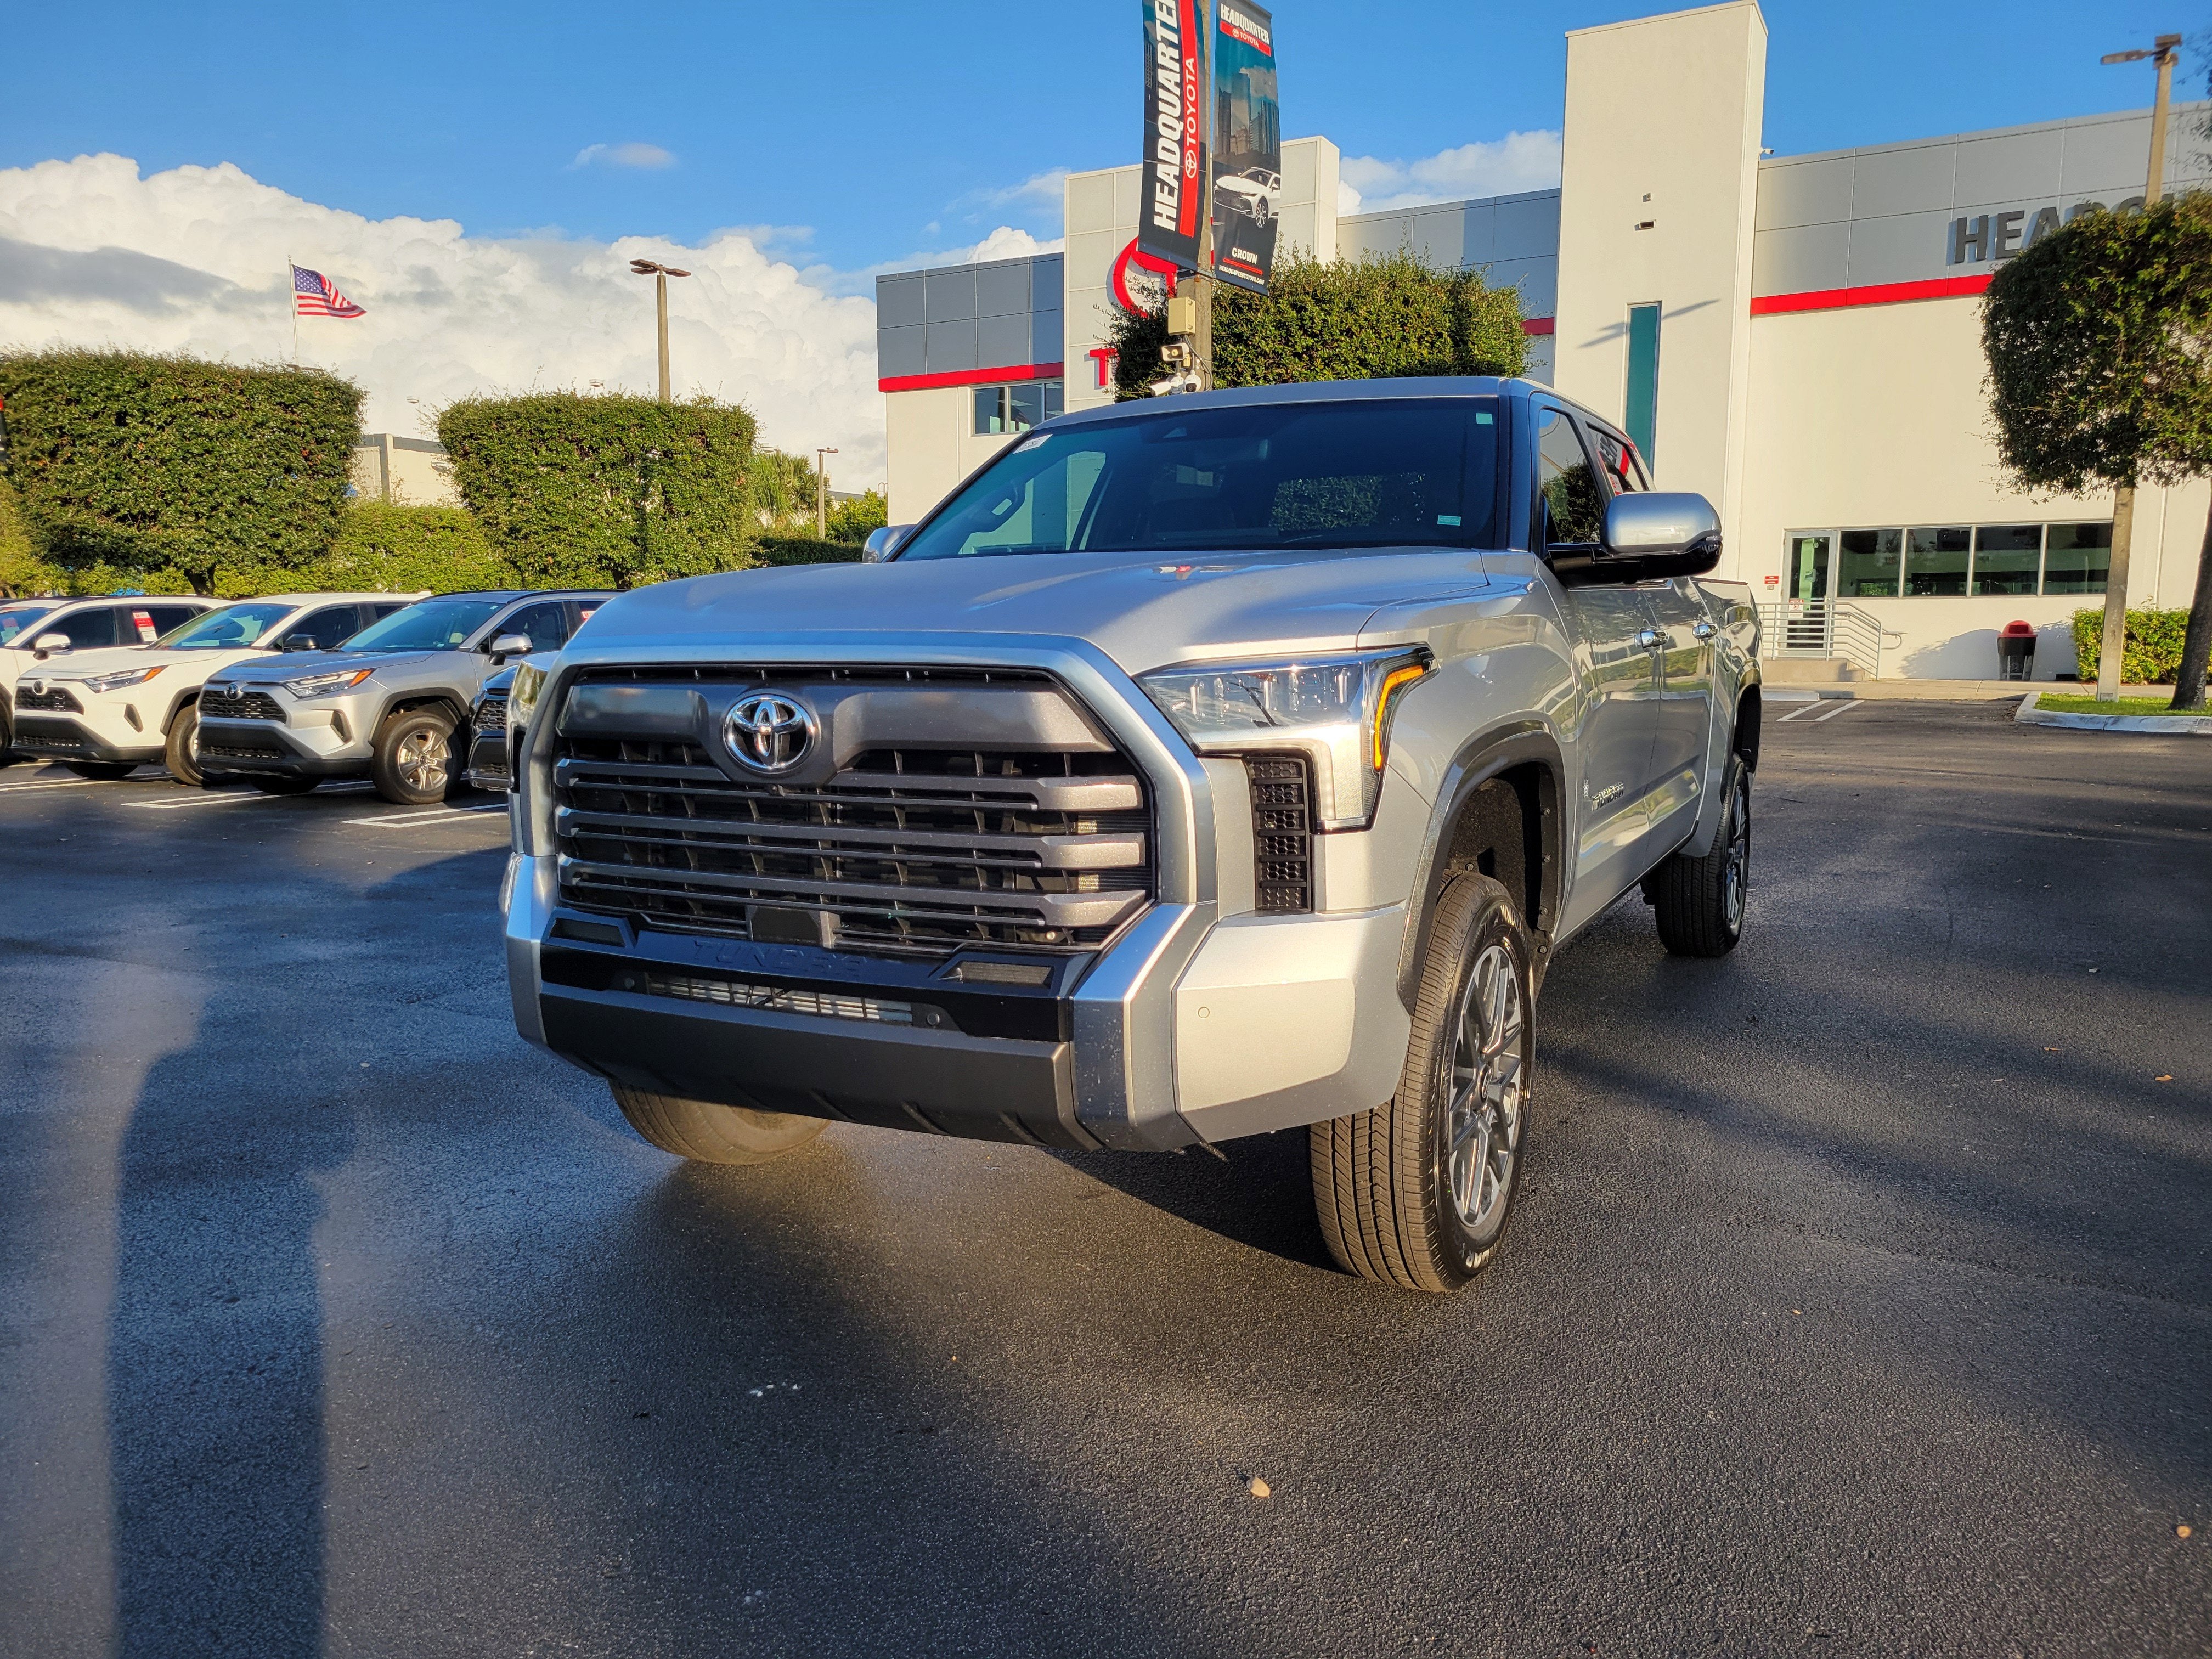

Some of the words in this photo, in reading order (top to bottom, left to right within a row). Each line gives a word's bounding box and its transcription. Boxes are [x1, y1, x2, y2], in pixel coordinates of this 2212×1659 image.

[1221, 3, 1269, 45] HEADQUARTER
[1239, 31, 1259, 48] TOYOTA
[1154, 0, 1184, 232] HEADQUARTE
[1186, 57, 1197, 146] TOYOTA
[1232, 247, 1258, 264] CROWN
[1218, 264, 1265, 285] HEADQUARTERTOYOTA.COM
[693, 940, 868, 976] TUNDRA
